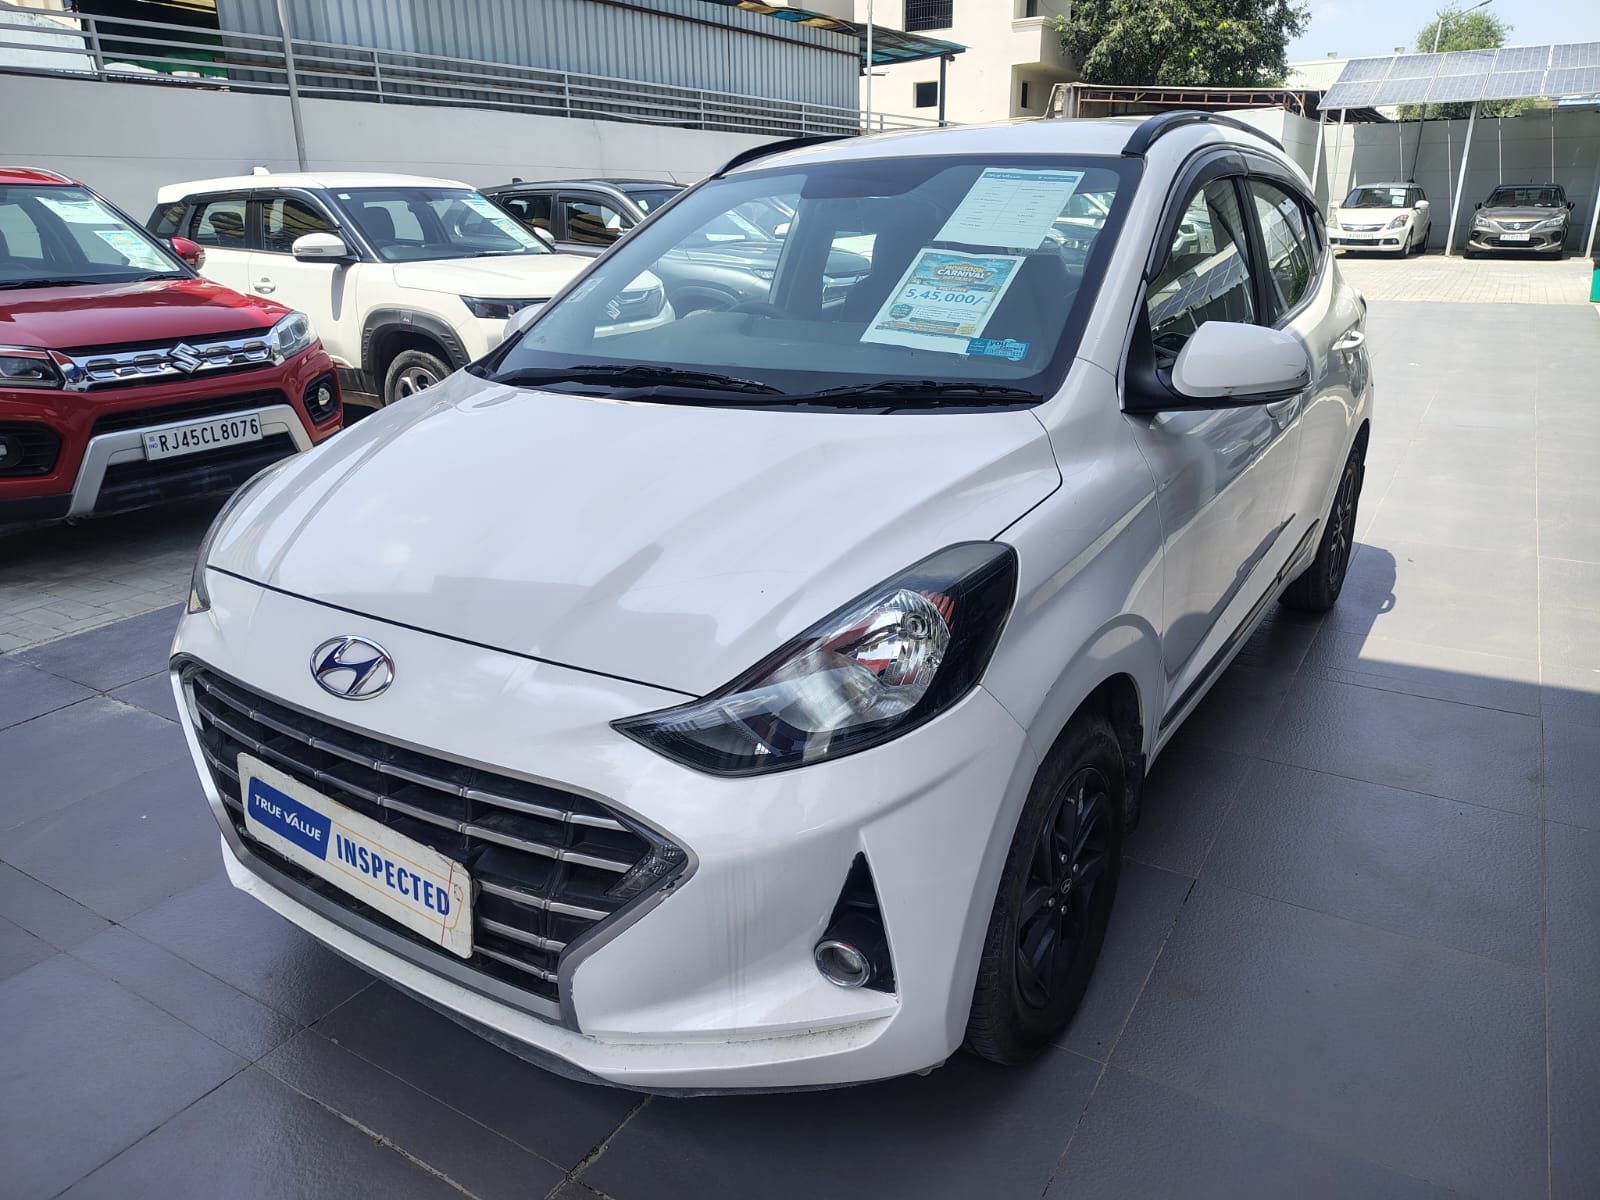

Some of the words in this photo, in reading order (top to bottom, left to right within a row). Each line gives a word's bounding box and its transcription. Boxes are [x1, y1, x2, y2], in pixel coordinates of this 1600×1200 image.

[937, 269, 985, 279] CARNIVAL
[159, 418, 259, 452] RJ45CL8076
[254, 793, 282, 819] TRUE
[283, 810, 322, 842] VALUE
[336, 833, 450, 917] INSPECTED
